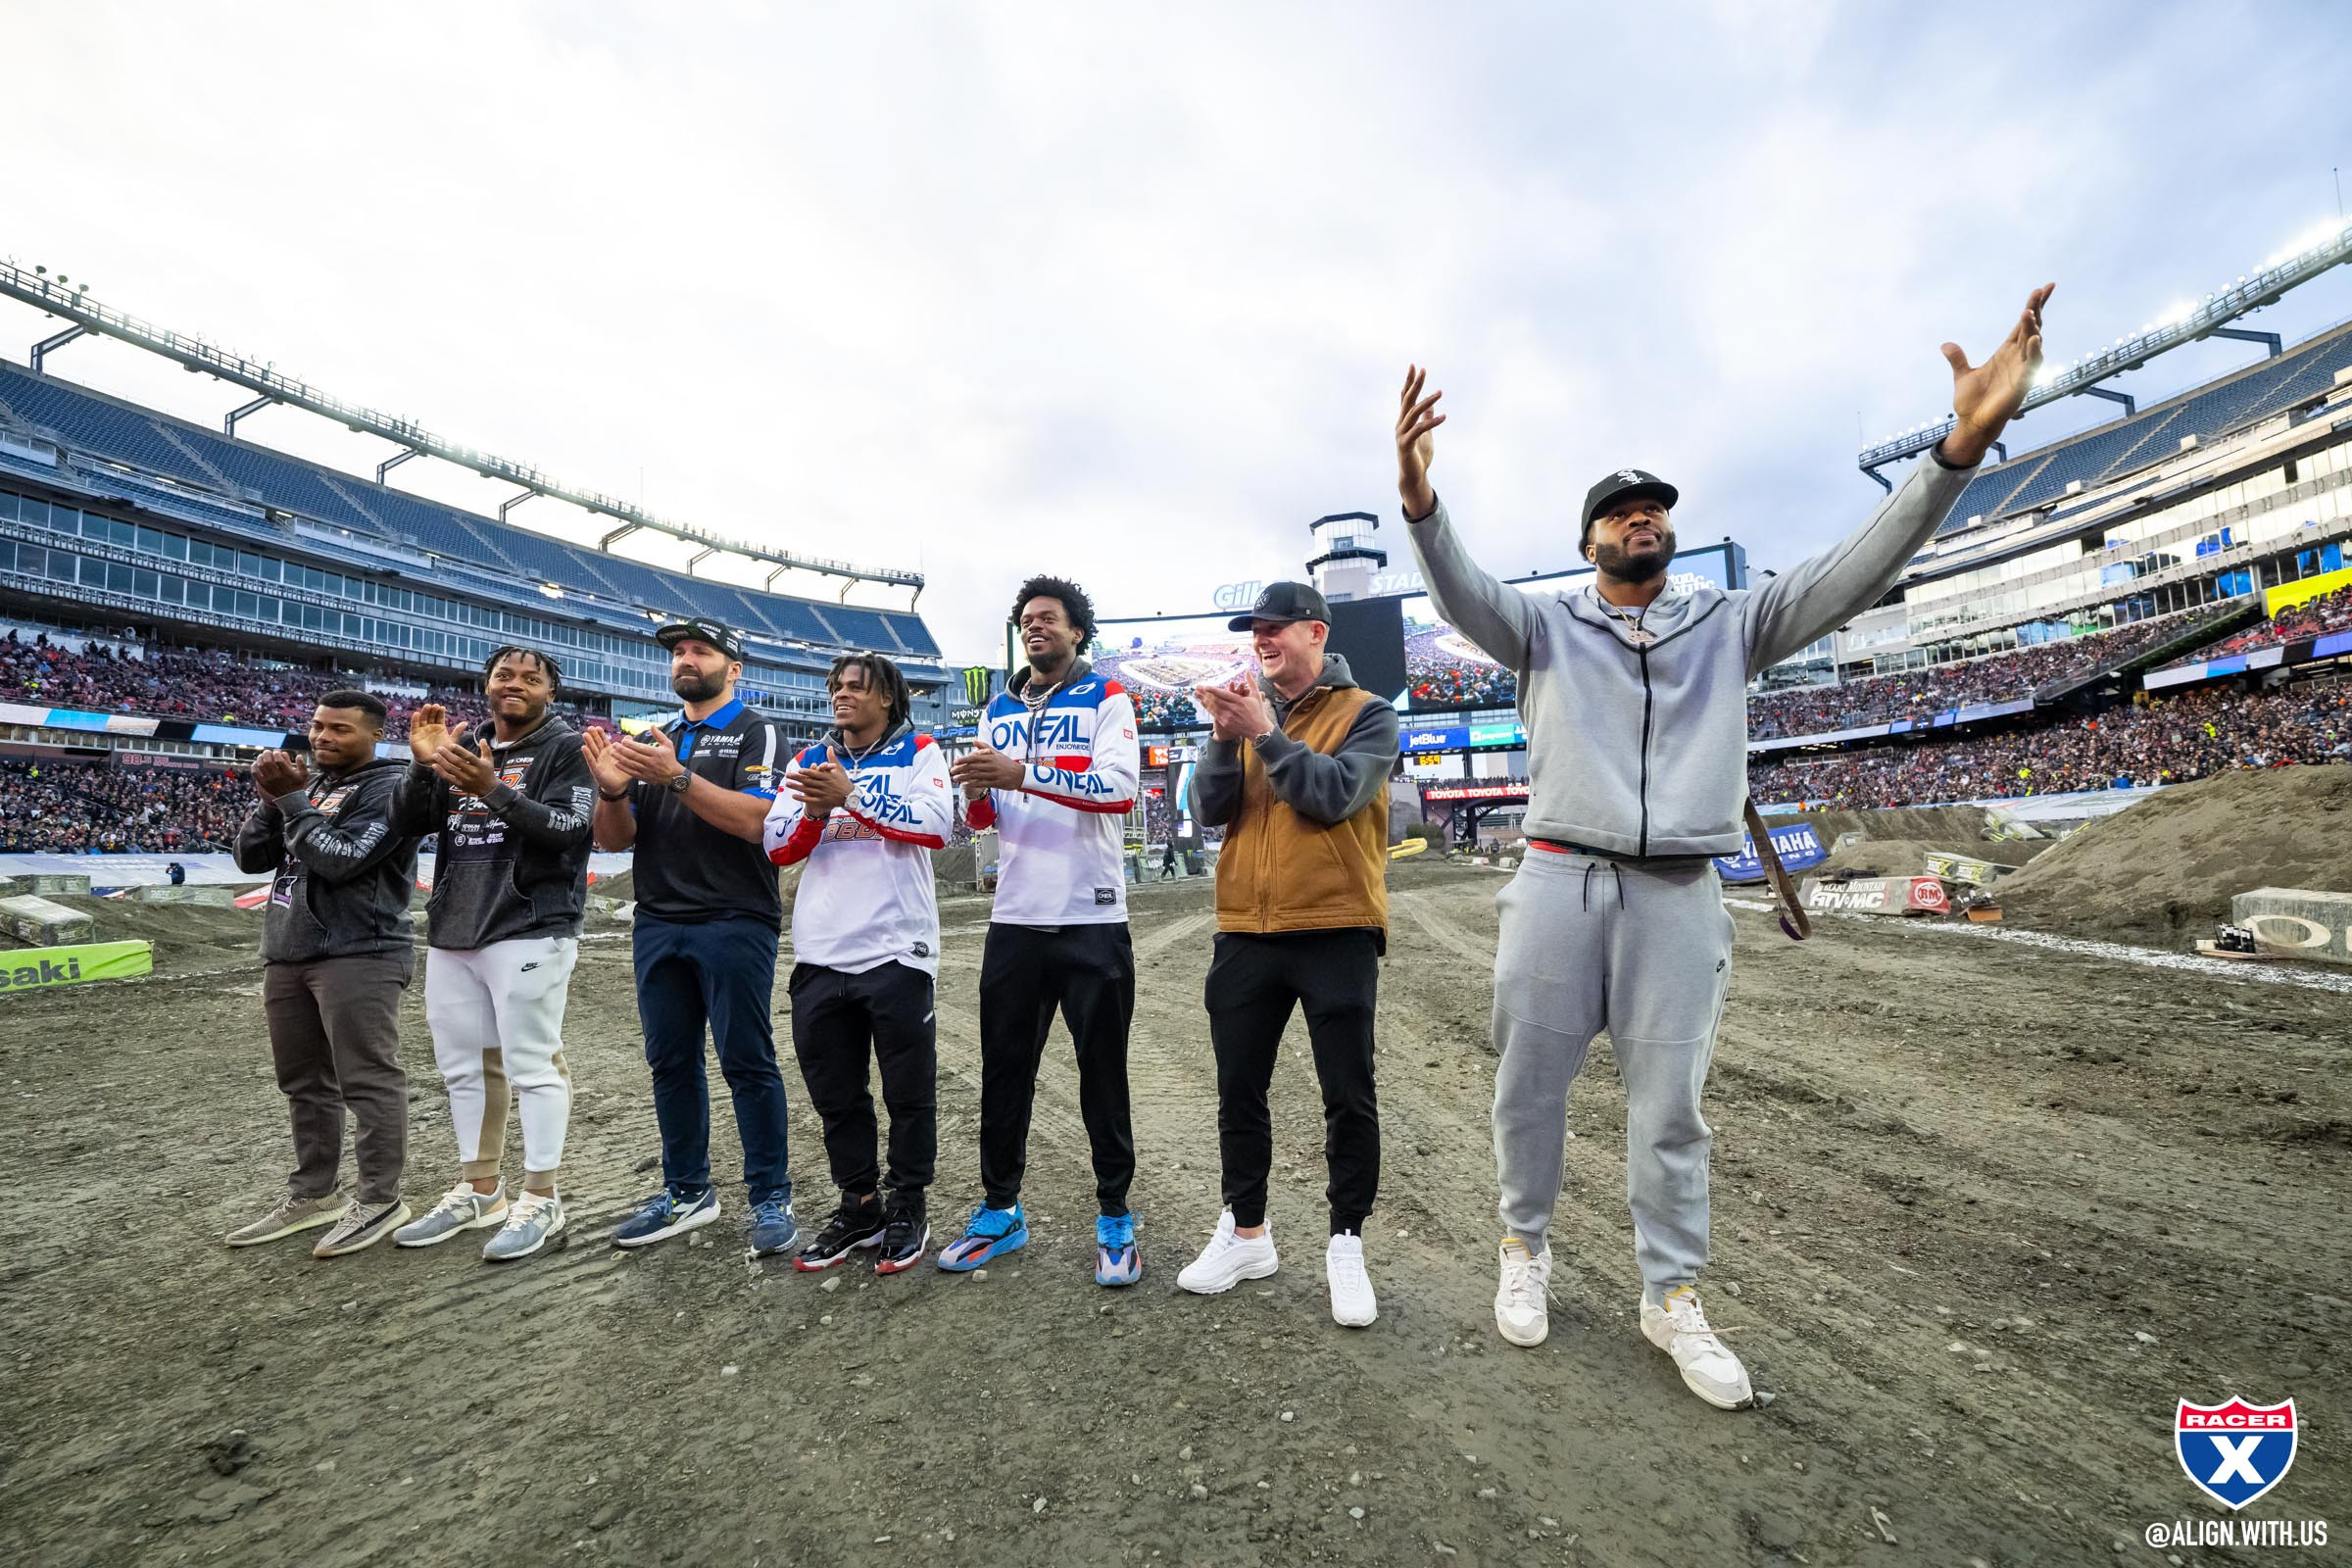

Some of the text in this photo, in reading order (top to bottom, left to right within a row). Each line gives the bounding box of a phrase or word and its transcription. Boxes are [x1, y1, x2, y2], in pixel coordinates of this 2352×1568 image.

[933, 727, 978, 739] SUPER
[1409, 733, 1446, 748] jetBlue
[1430, 790, 1465, 800] TOYOTA
[1467, 786, 1503, 797] TOYOTA
[1742, 831, 1819, 858] YAHA
[1731, 850, 1816, 869] RAING
